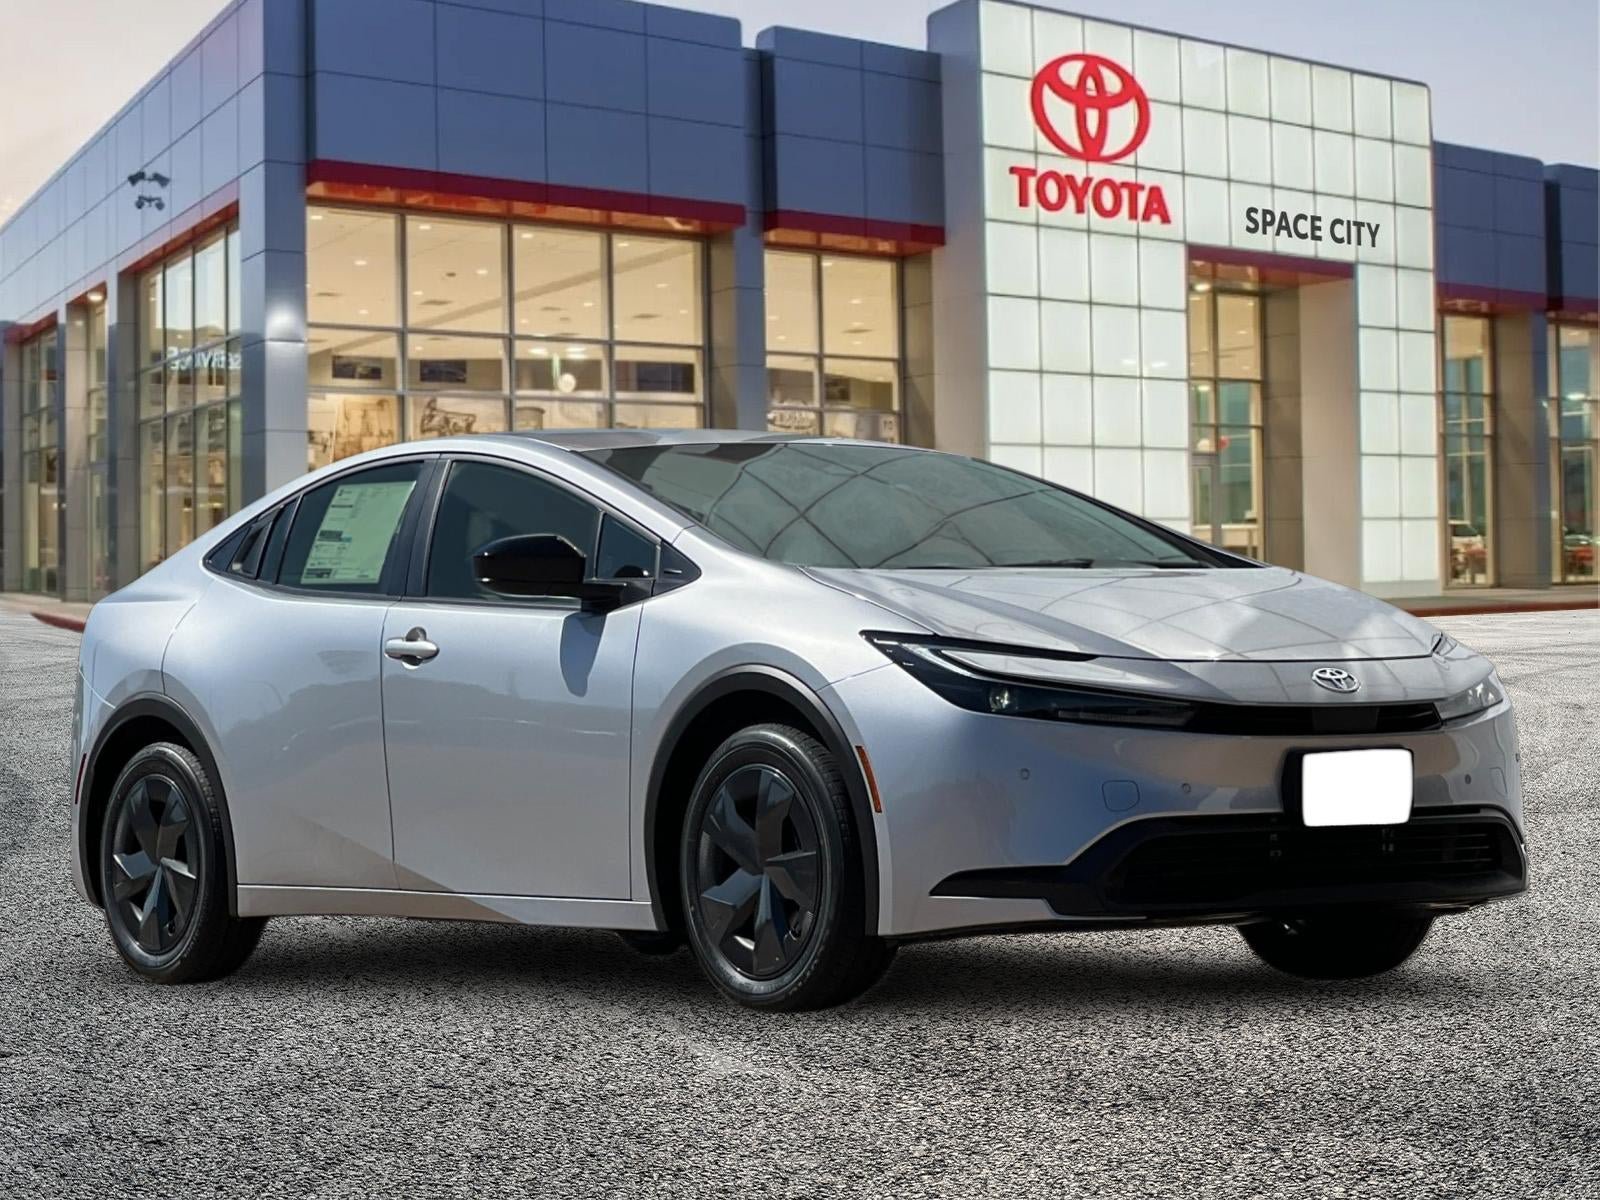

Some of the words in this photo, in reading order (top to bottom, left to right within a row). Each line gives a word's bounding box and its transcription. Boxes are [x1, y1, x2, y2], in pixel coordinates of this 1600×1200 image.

[1009, 166, 1171, 225] TOYOTA
[1245, 206, 1323, 242] SPACE
[1329, 218, 1381, 248] CITY
